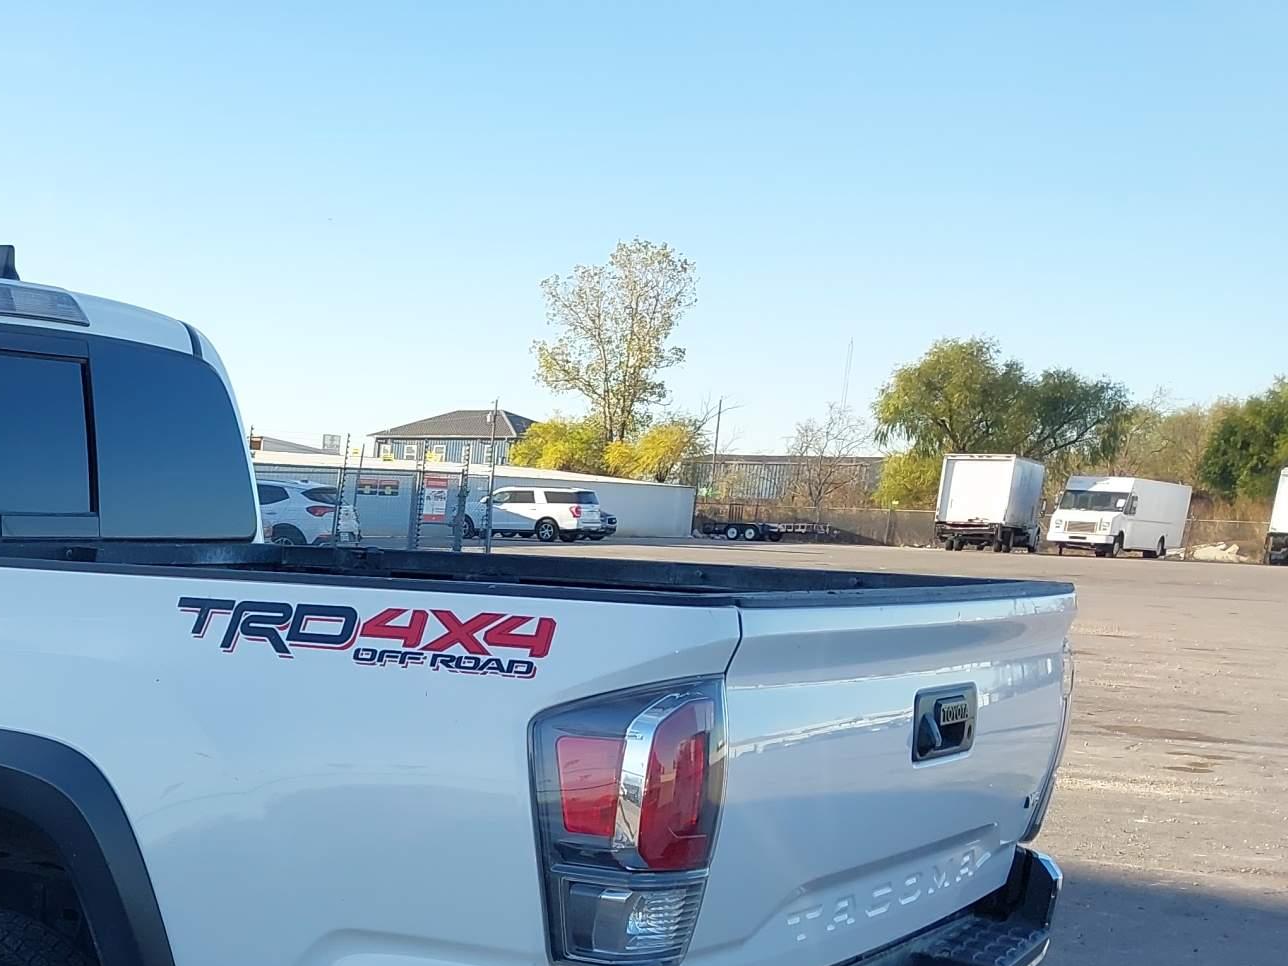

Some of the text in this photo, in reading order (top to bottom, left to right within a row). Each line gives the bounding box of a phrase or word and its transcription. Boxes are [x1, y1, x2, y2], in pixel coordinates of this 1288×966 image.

[178, 597, 557, 659] TRD 4X4
[430, 653, 537, 680] ROAD
[942, 703, 969, 723] TOYOTA
[786, 846, 992, 942] TACOMA
